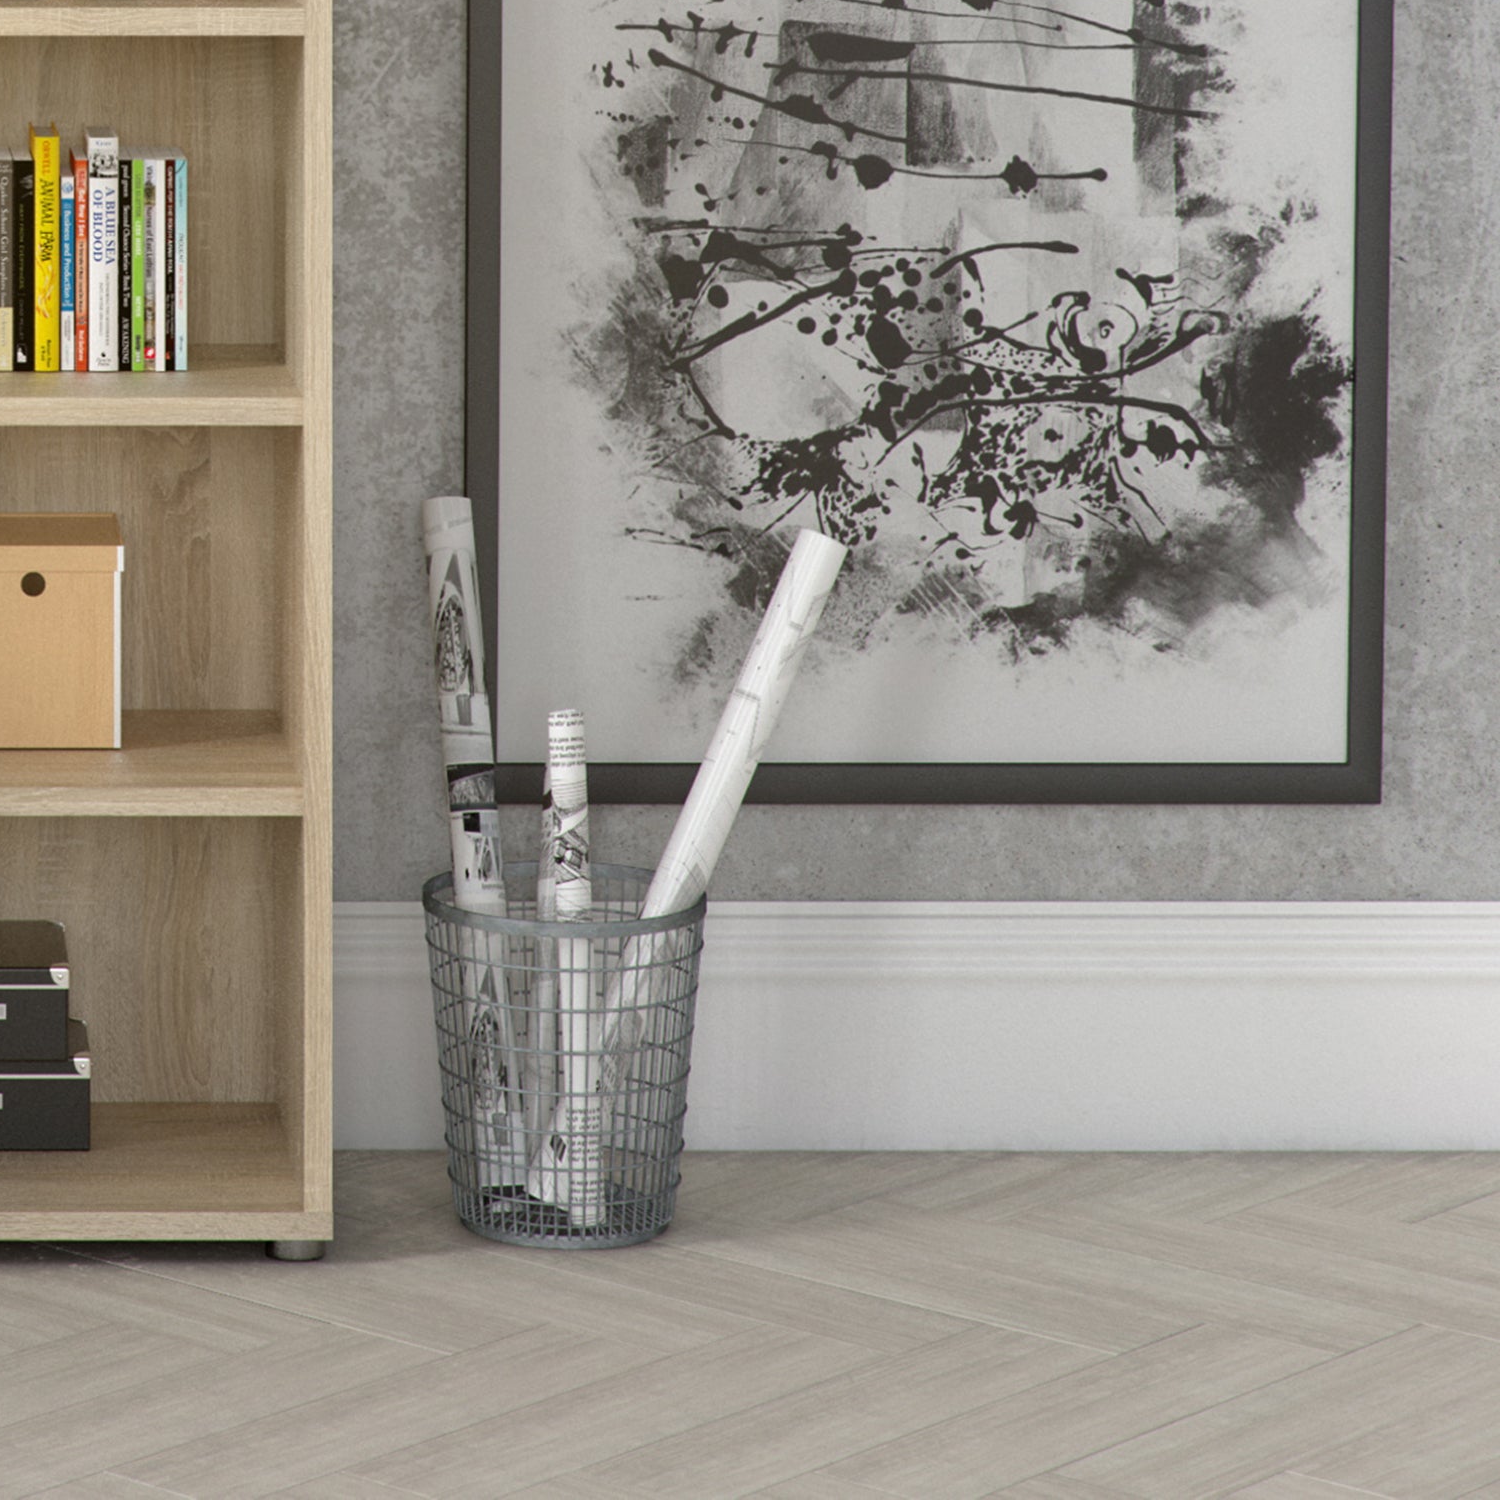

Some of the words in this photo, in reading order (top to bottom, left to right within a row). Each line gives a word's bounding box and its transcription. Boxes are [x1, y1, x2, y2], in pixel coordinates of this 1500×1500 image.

[42, 140, 51, 176] ORWELL
[40, 178, 55, 227] ANIMAL
[93, 189, 104, 208] OF
[105, 187, 116, 197] A
[64, 209, 73, 242] Business
[105, 201, 116, 237] BLUE
[40, 230, 55, 262] FARM
[64, 243, 73, 257] and
[93, 212, 104, 263] BLOOD
[105, 240, 116, 265] SEA
[64, 258, 73, 300] Production
[121, 317, 130, 364] AWAKENING
